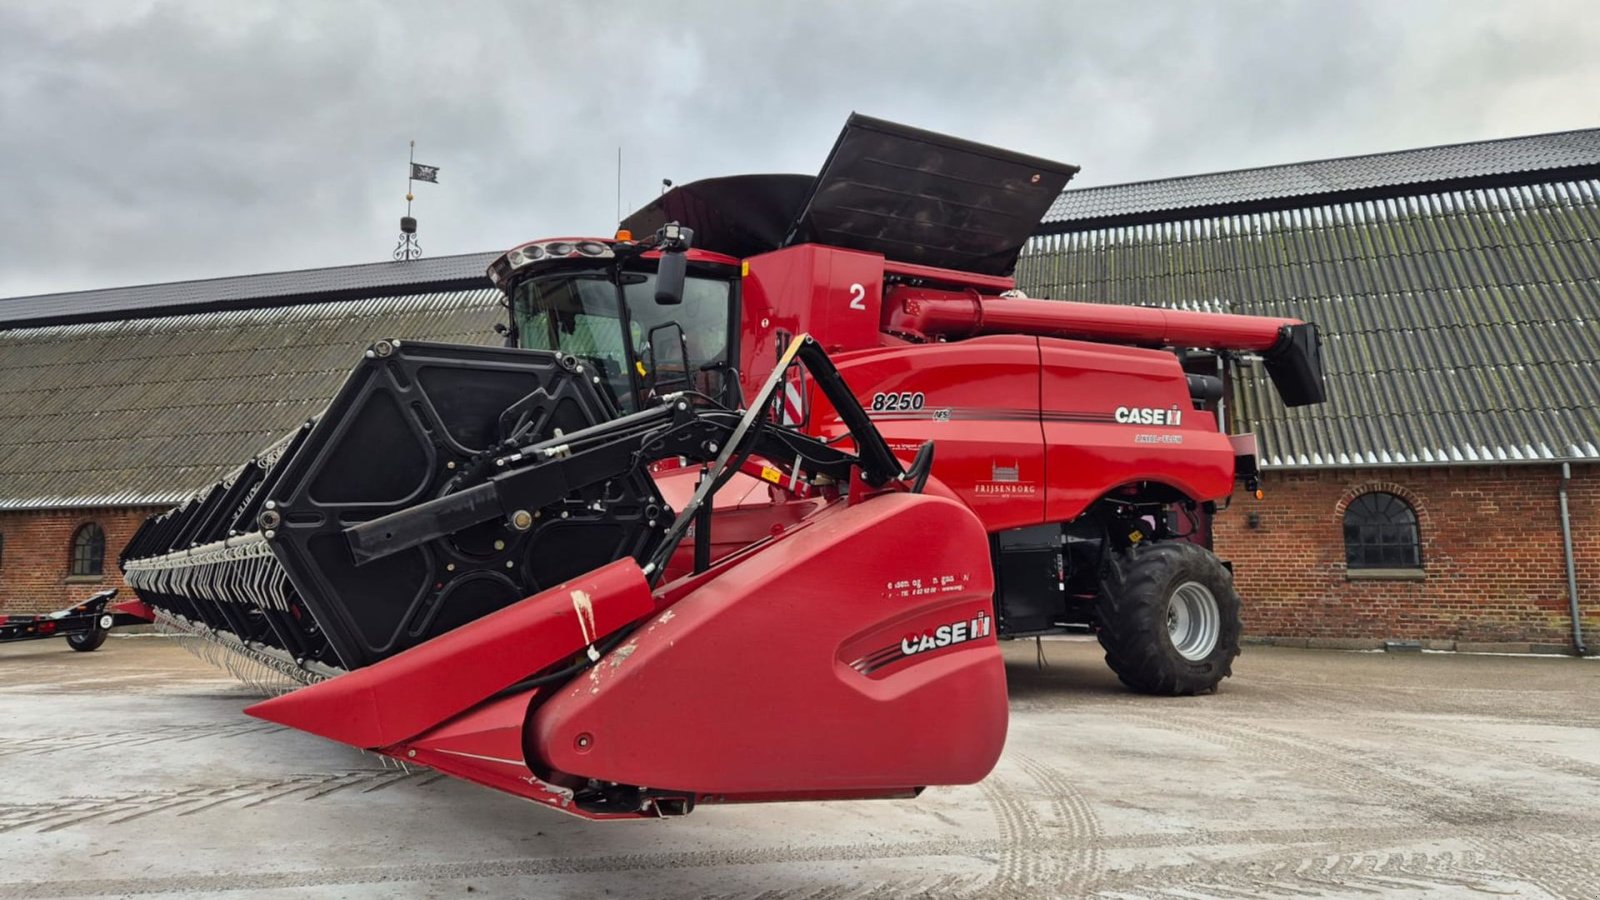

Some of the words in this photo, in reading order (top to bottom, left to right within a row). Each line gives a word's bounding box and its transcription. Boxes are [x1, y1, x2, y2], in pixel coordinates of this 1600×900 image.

[850, 283, 866, 310] 2
[871, 391, 925, 412] 8250
[1115, 406, 1165, 425] CASE
[975, 484, 1035, 494] FRIJSENBORG
[901, 621, 967, 655] CASE
